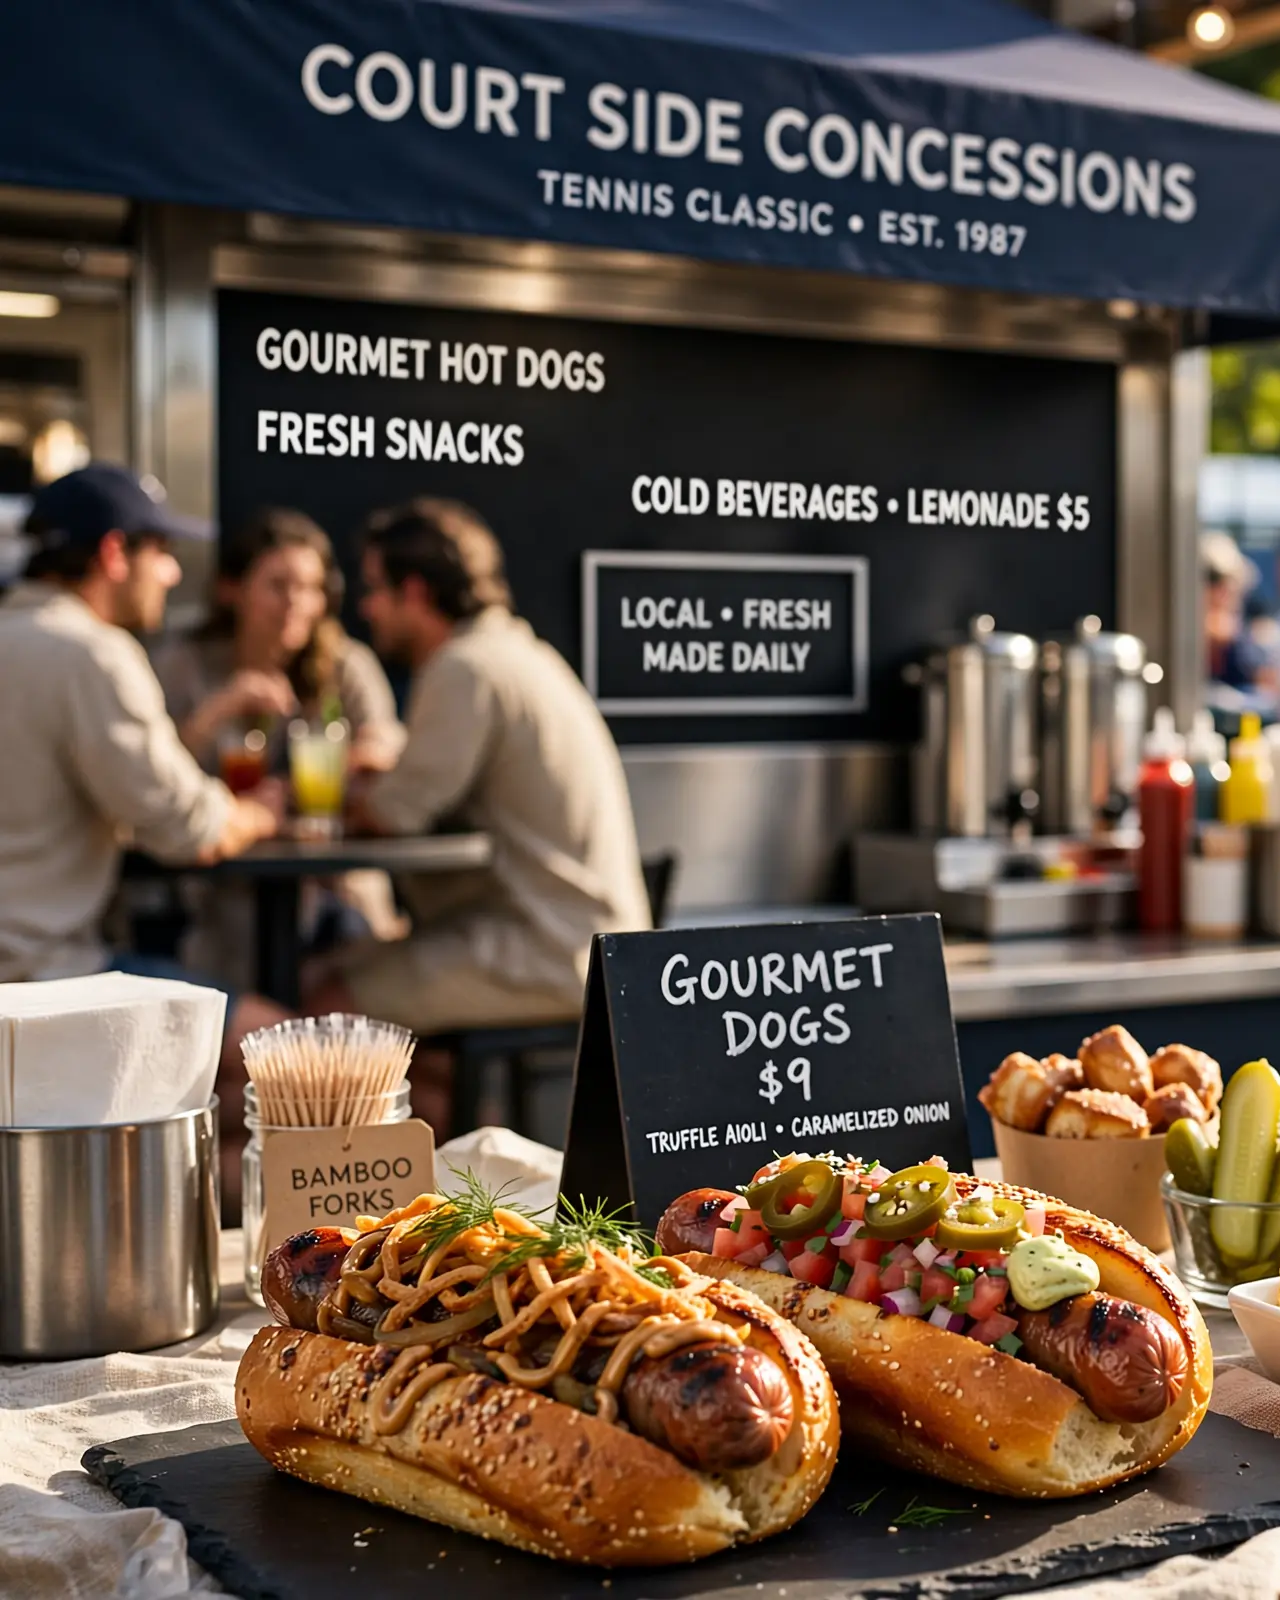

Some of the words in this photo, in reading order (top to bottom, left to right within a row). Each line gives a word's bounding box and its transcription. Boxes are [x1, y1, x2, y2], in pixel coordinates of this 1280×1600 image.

[301, 44, 565, 141] COURT
[587, 83, 743, 165] SIDE
[764, 106, 1197, 223] CONCESSIONS
[537, 169, 674, 218] TENNIS
[685, 188, 833, 236] CLASSIC
[879, 210, 944, 248] EST.
[955, 220, 1027, 256] 1987
[256, 327, 431, 380] GOURMET
[440, 341, 509, 385] HOT
[516, 346, 606, 393] DOGS
[257, 410, 375, 458] FRESH
[385, 417, 525, 466] SNACKS
[631, 474, 710, 515] COLD
[717, 478, 879, 523] BEVERAGES
[907, 488, 1050, 529] LEMONADE
[1056, 492, 1090, 532] $5
[621, 597, 713, 629] LOCAL
[743, 598, 831, 630] FRESH
[643, 641, 724, 673] MADE
[732, 641, 811, 673] DAILY
[660, 943, 894, 1006] GOURMET
[721, 1002, 851, 1057] DOGS
[759, 1058, 811, 1104] $9
[645, 1126, 720, 1154] TRUFFLE
[725, 1121, 767, 1146] AIOLI
[791, 1107, 899, 1138] CARAMELIZED
[903, 1101, 950, 1125] ONION
[292, 1158, 412, 1190] BAMBOO
[310, 1188, 394, 1217] FORKS
